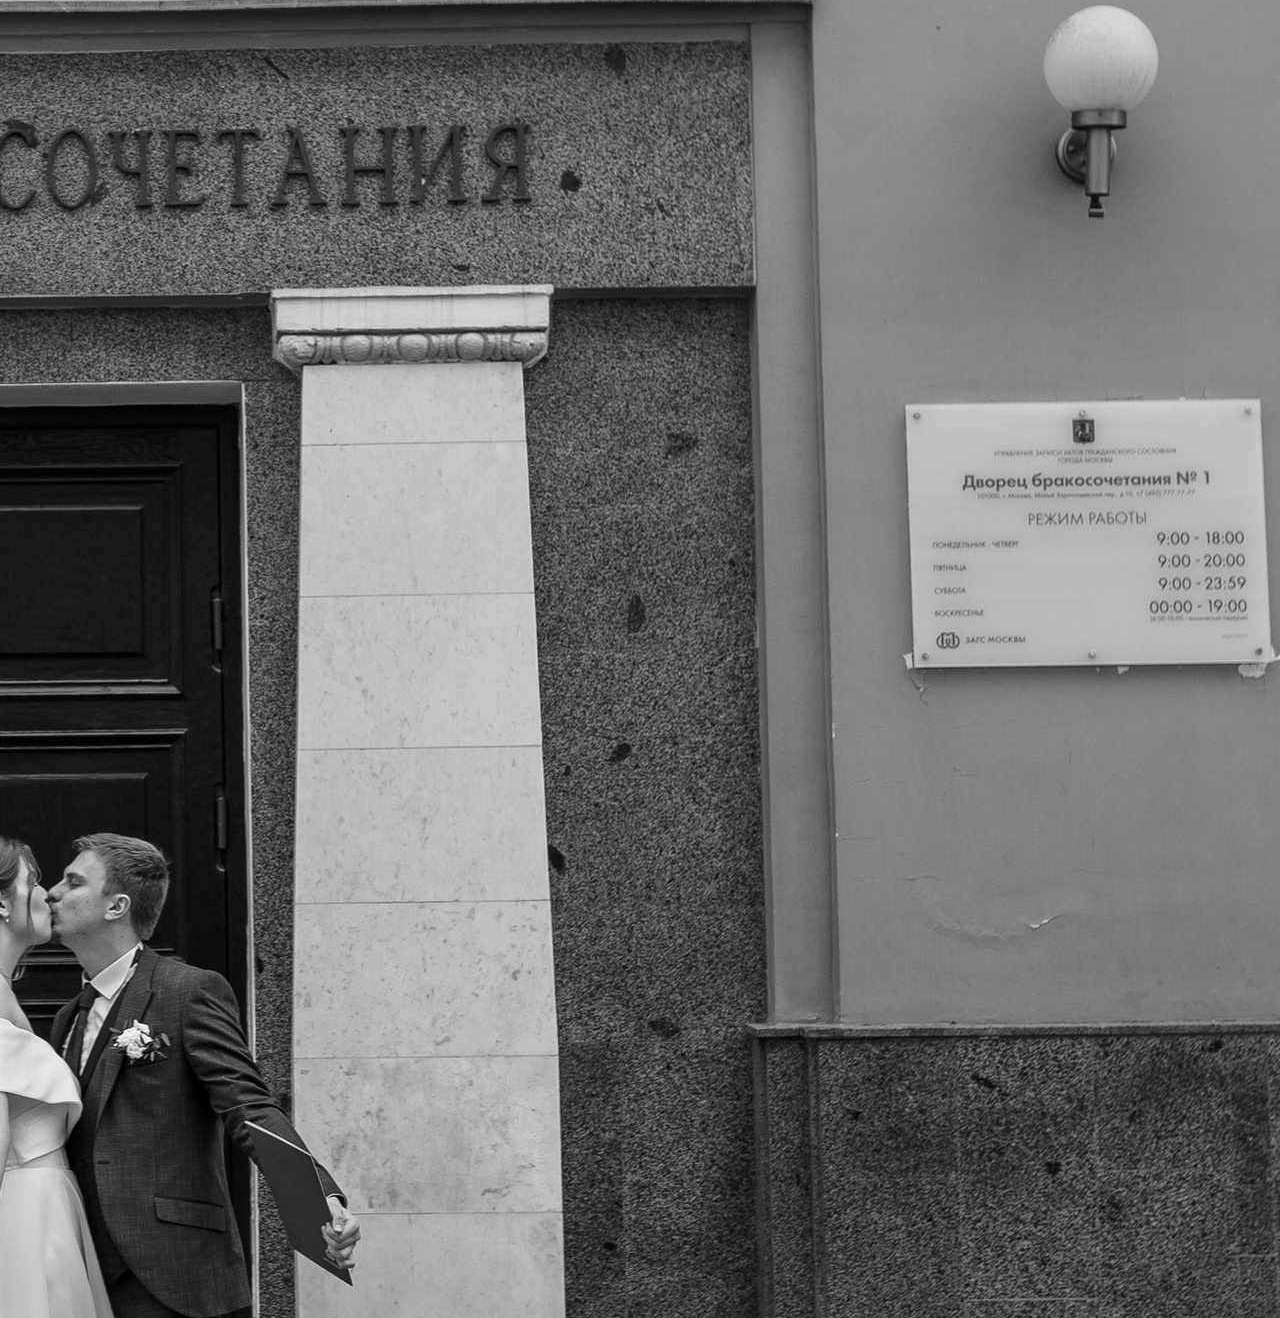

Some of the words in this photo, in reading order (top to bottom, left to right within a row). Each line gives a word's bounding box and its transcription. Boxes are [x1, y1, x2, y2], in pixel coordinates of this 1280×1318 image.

[962, 474, 1028, 491] Дворец
[1032, 471, 1171, 491] бракосочетания
[1203, 470, 1210, 484] 1
[1028, 512, 1084, 526] РЕЖИМ
[1088, 510, 1147, 526] РАБОТЫ
[932, 541, 986, 550] ПОНЕДЕЛЬНИК
[992, 540, 1019, 548] ЧЕТВЕРГ
[1156, 531, 1190, 546] 9:00
[1206, 530, 1245, 545] 18:00
[933, 564, 967, 572] ПЯТНИЦА
[1157, 553, 1191, 569] 9:00
[1203, 553, 1246, 568] 20:00
[934, 586, 966, 595] СУББОТА
[1158, 576, 1192, 591] 9:00
[1204, 575, 1247, 591] 23:59
[934, 609, 984, 617] ВОСКРЕСЕНЬЕ
[1149, 599, 1193, 614] 00:00
[1208, 598, 1248, 613] 19:00
[965, 636, 986, 644] ЗАГС
[987, 635, 1026, 644] МОСКВЫ
